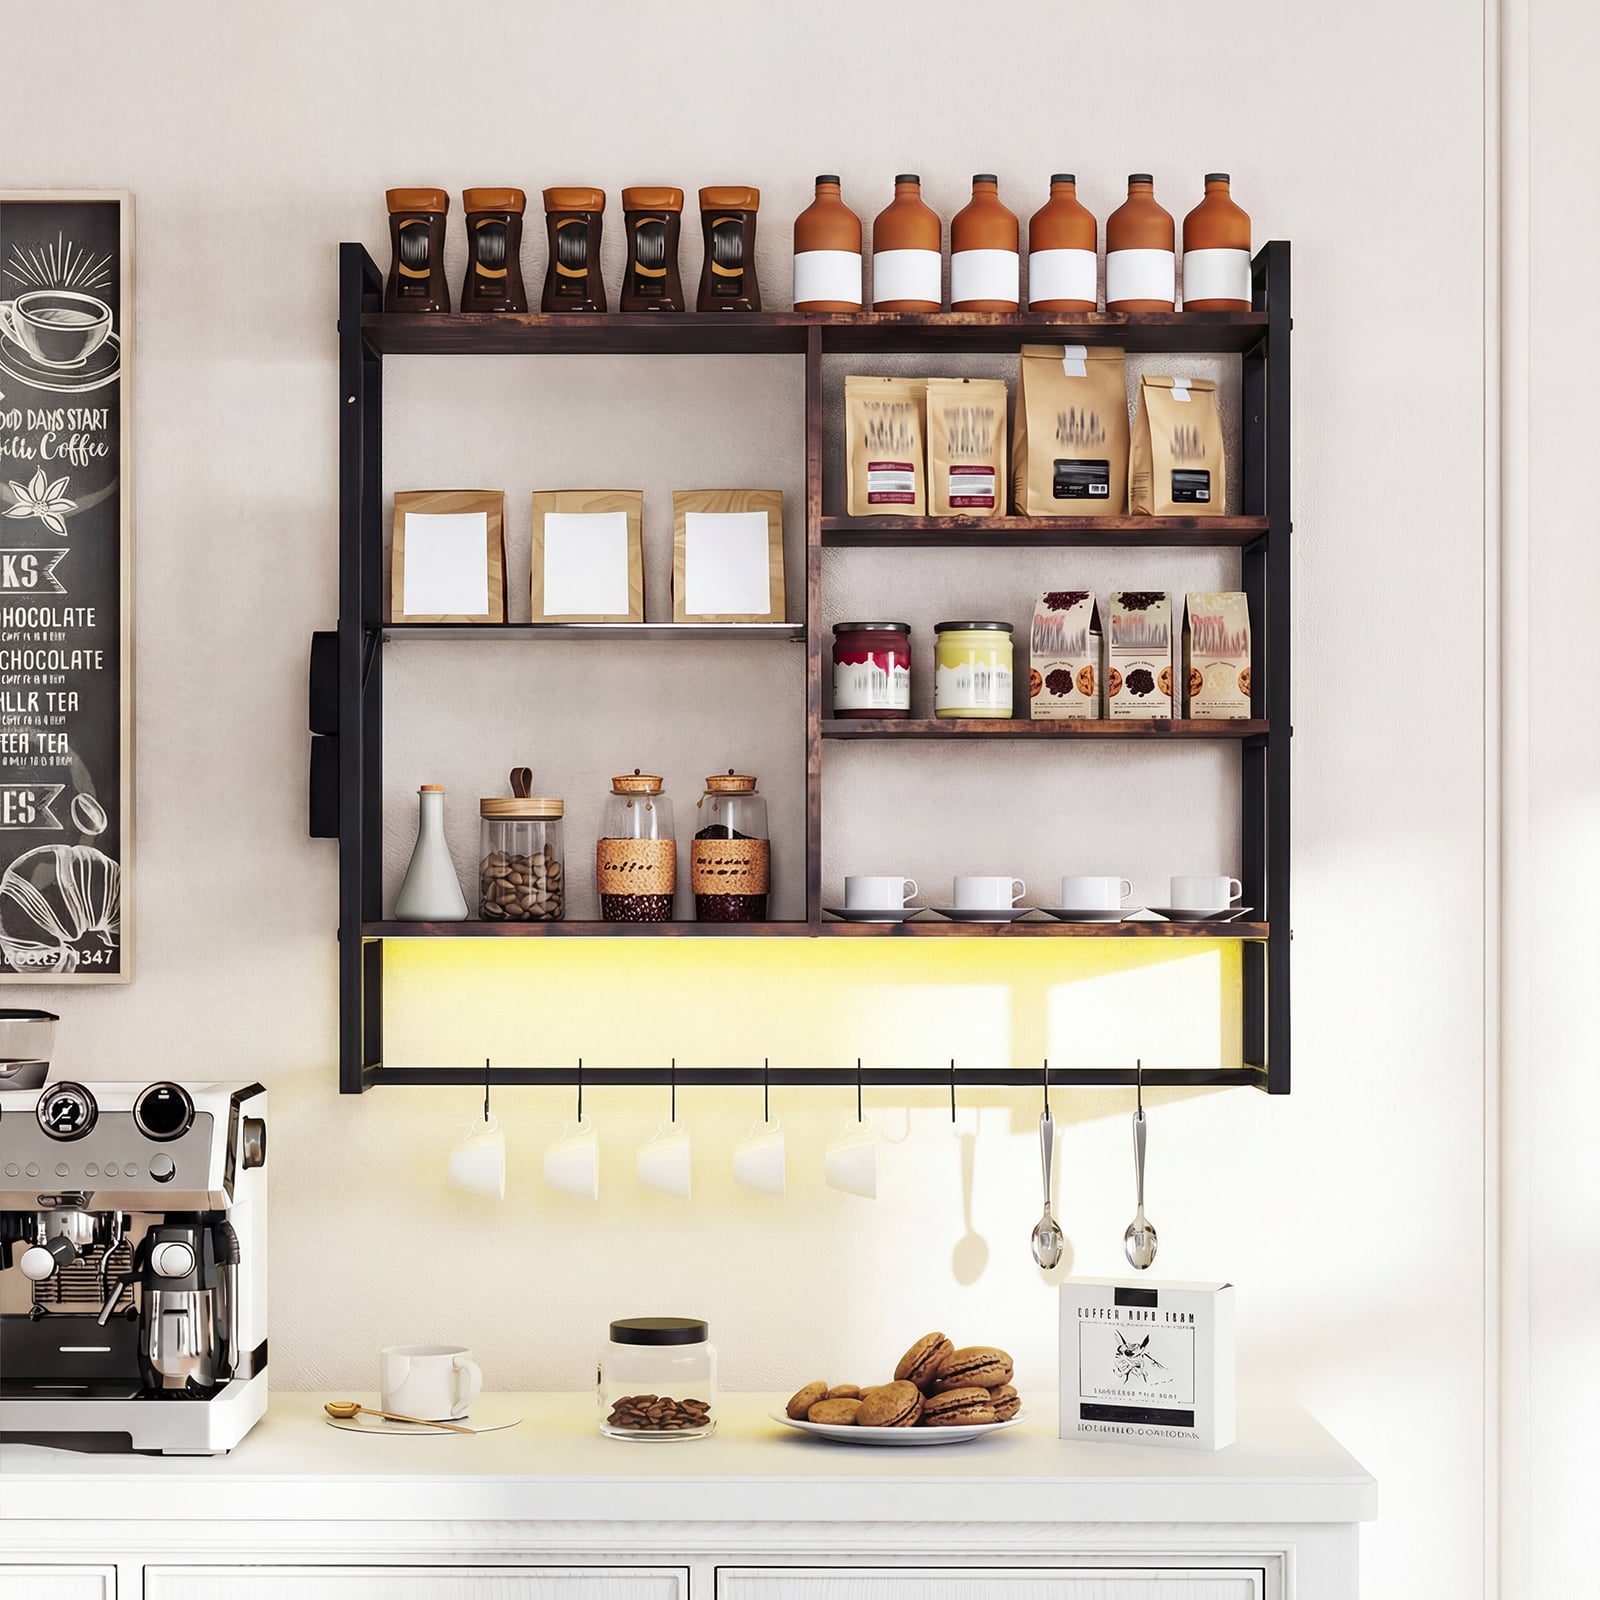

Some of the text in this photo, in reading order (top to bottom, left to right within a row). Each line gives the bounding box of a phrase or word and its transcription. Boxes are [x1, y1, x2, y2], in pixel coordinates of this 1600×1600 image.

[67, 408, 109, 431] START
[40, 431, 109, 466] Coffee
[2, 554, 39, 588] KS
[0, 607, 96, 628] HOCOLATE
[0, 650, 103, 670] CHOCOLATE
[46, 691, 79, 712] TEA
[36, 733, 69, 754] TEA
